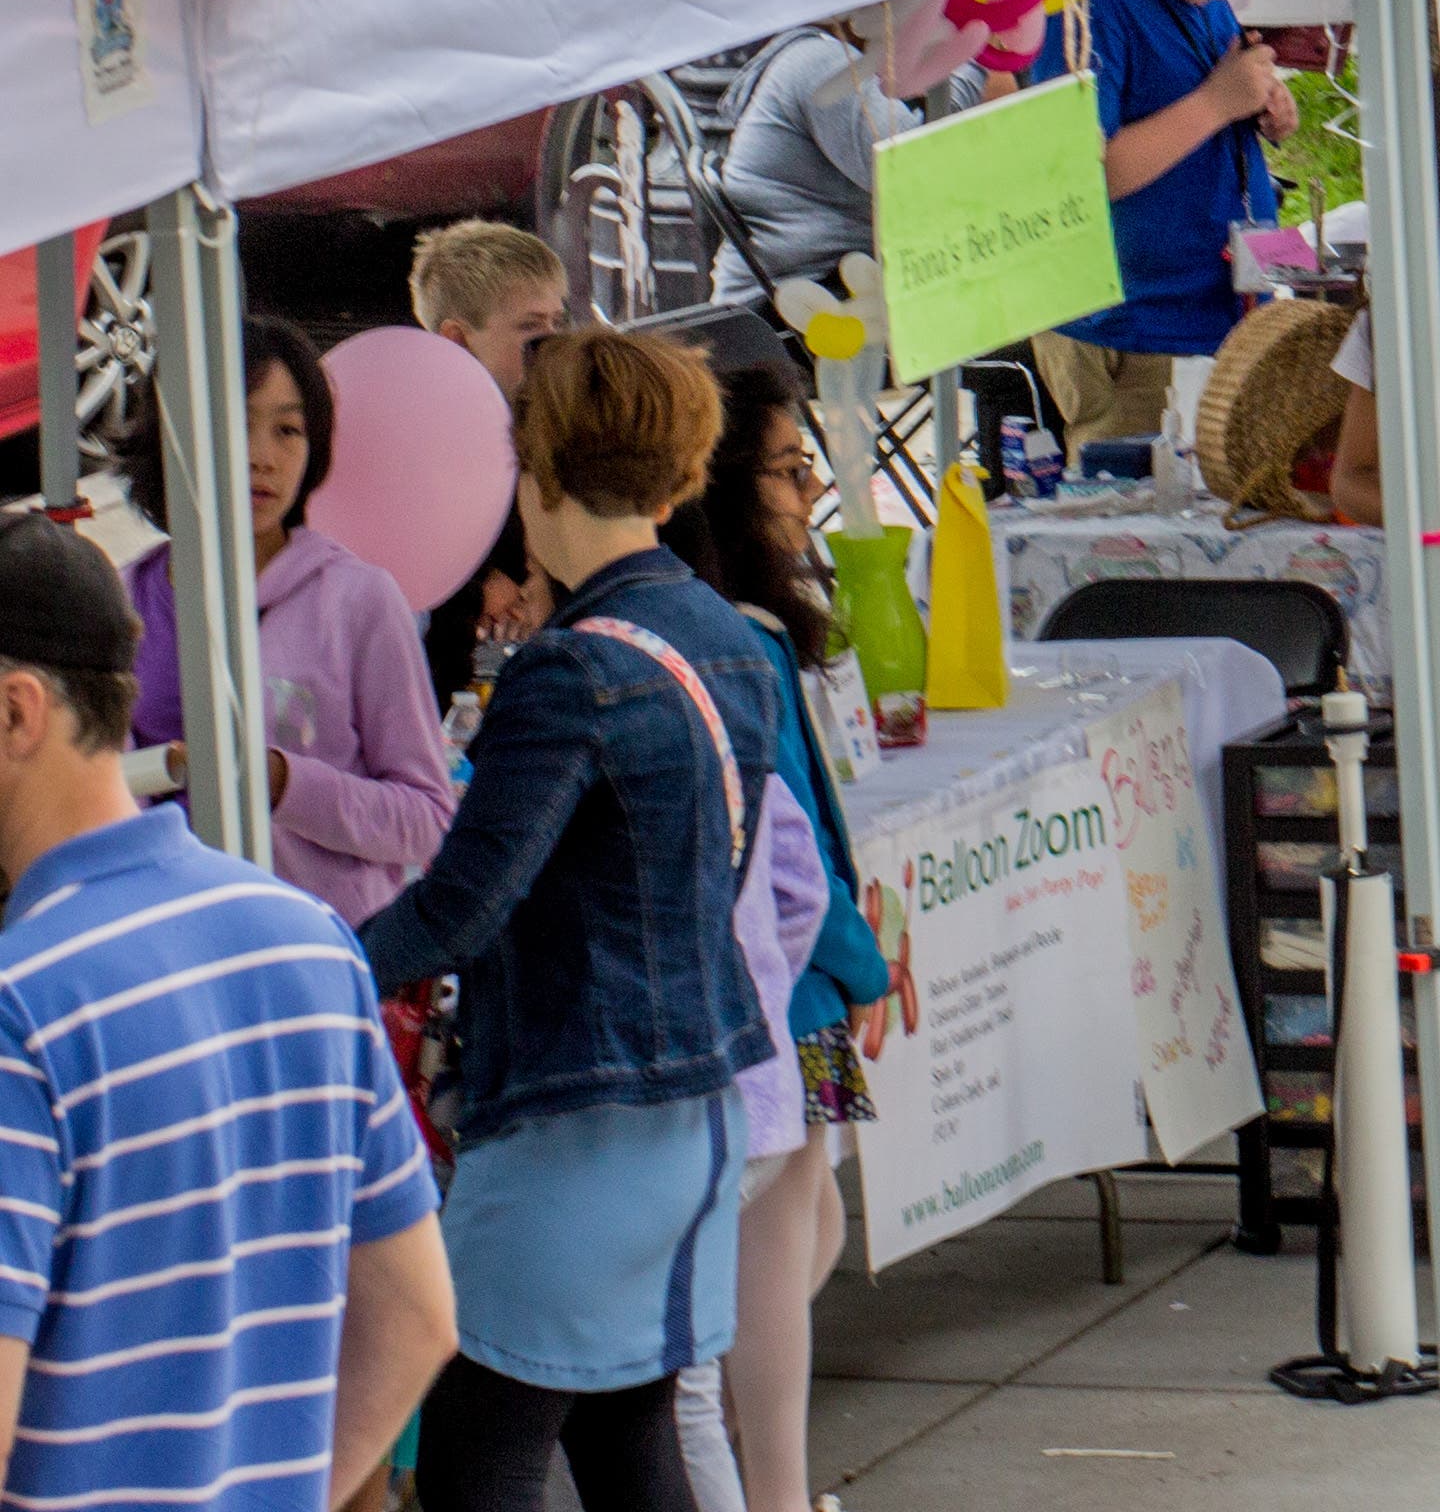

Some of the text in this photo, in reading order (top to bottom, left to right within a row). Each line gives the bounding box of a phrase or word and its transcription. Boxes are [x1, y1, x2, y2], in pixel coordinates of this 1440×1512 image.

[965, 222, 998, 264] Bee
[918, 834, 1010, 912] Balloon
[1013, 803, 1107, 870] Zoom
